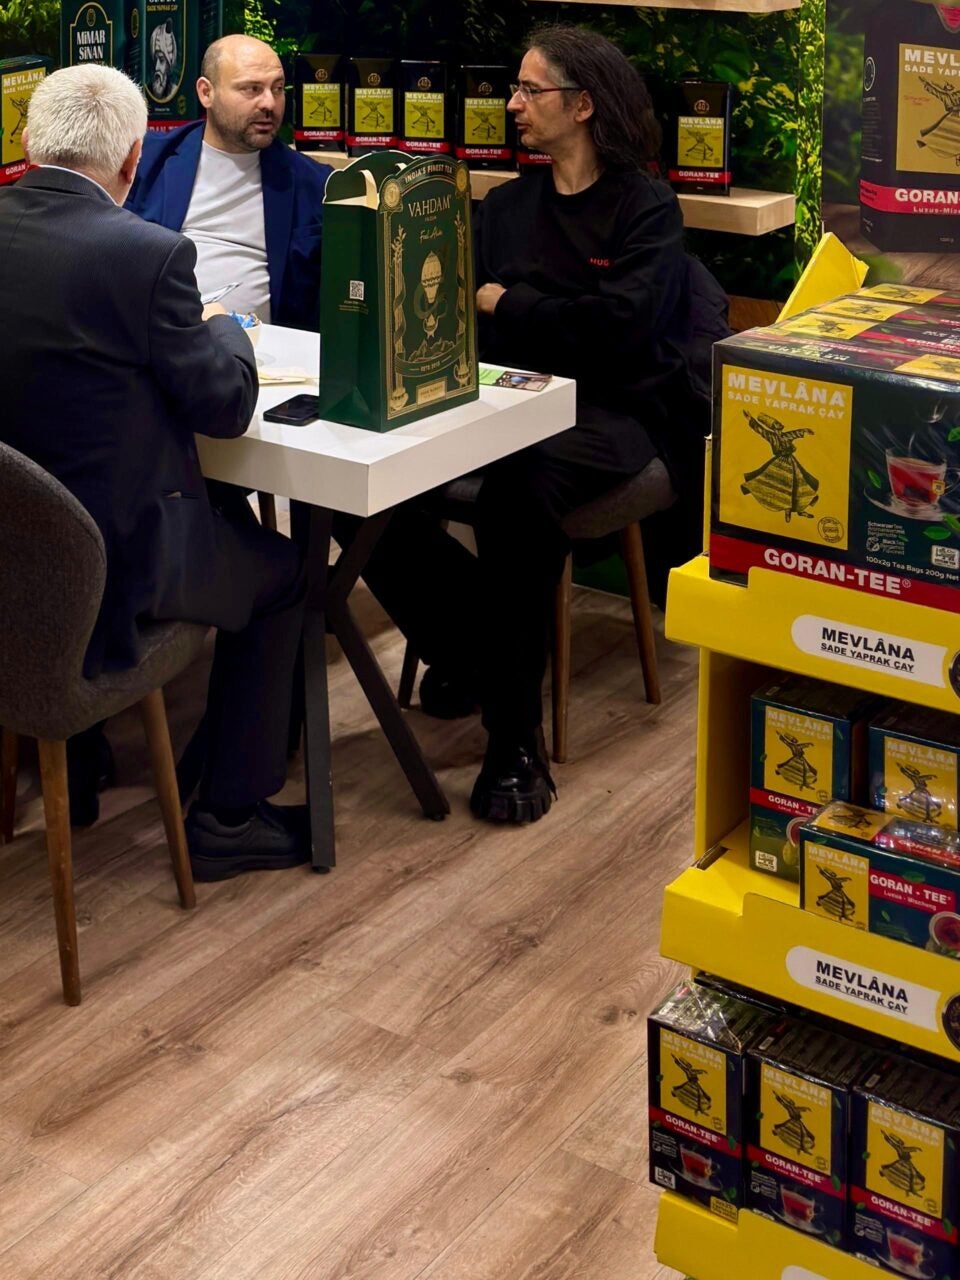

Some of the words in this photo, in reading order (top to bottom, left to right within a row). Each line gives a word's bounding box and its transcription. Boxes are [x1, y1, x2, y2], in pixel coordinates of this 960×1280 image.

[904, 48, 960, 67] MEVL
[904, 64, 933, 74] SADE
[938, 66, 960, 76] YAP
[408, 194, 451, 217] VAHDAM
[895, 188, 960, 203] GORAN-
[728, 372, 845, 407] MEVLÂNA
[728, 391, 759, 405] SADE
[764, 398, 815, 416] YAPRAK
[819, 407, 845, 419] ÇAY
[866, 555, 891, 568] 100x2g
[892, 561, 905, 570] Tea
[907, 564, 924, 575] Bags
[925, 568, 945, 579] 200g
[946, 573, 959, 581] Net
[822, 626, 915, 662] MEVLÂNA
[820, 641, 846, 656] SADE
[850, 649, 891, 668] YAPRAK
[894, 659, 915, 674] ÇAY
[768, 794, 799, 810] GORAN
[870, 874, 913, 895] GORAN
[815, 975, 841, 990] SADE
[844, 985, 885, 1006] YAPRAK
[887, 999, 908, 1014] ÇAY
[816, 960, 908, 1003] MEVLÂNA
